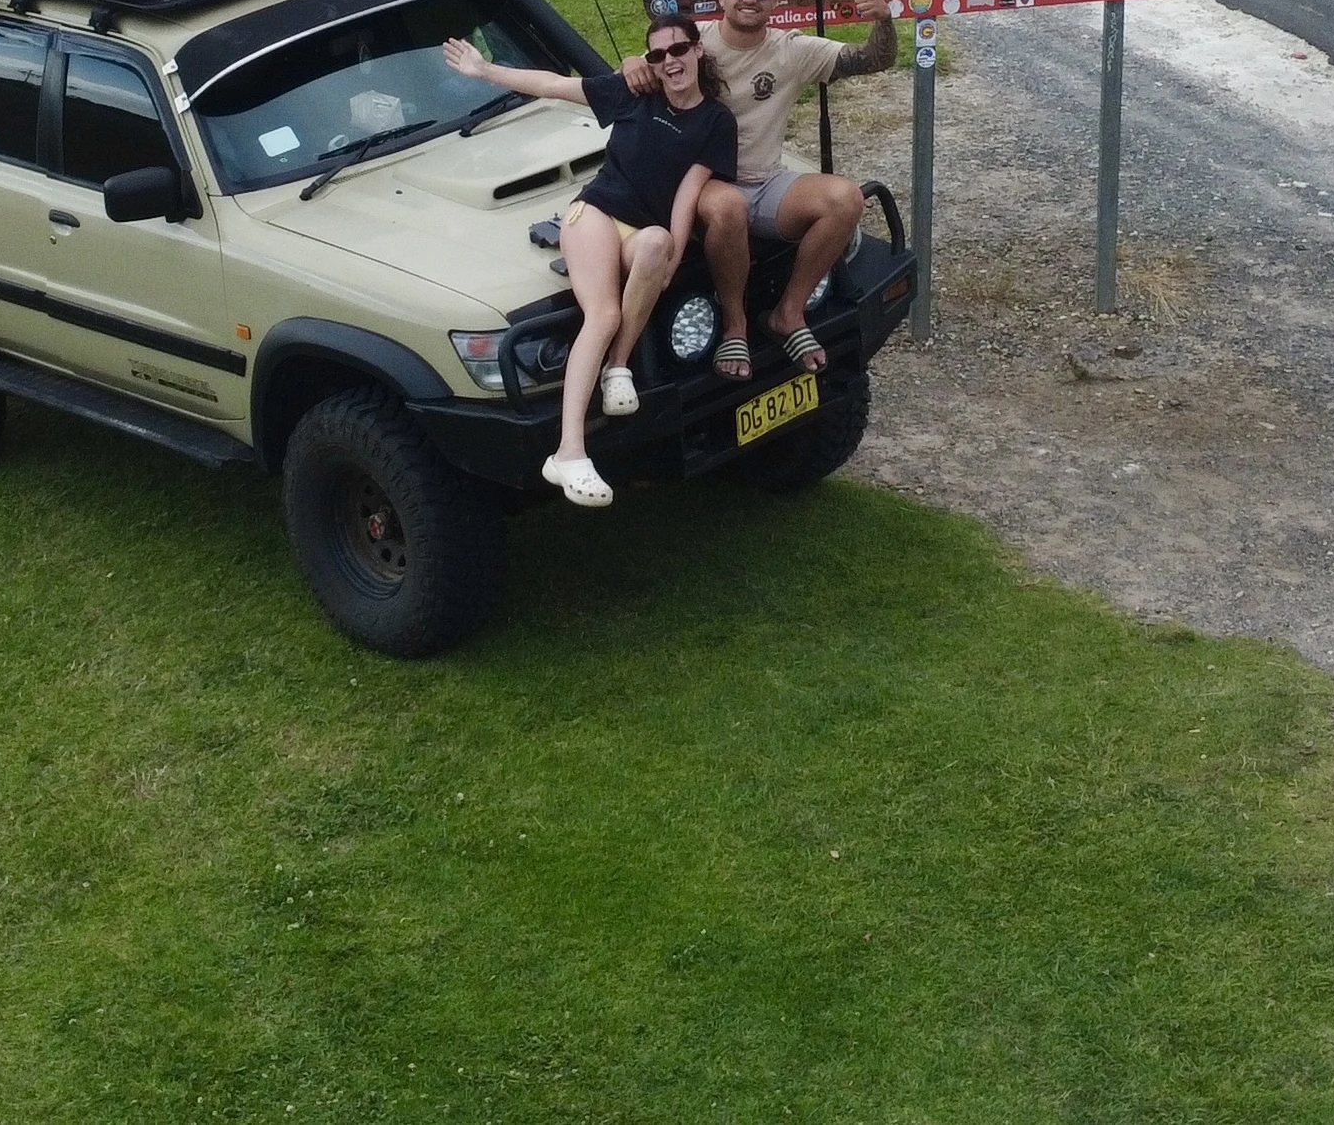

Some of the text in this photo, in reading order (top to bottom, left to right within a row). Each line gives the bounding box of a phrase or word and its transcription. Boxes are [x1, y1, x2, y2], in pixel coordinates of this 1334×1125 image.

[768, 10, 836, 25] ralia.cm
[741, 377, 813, 436] DG 82 DT
